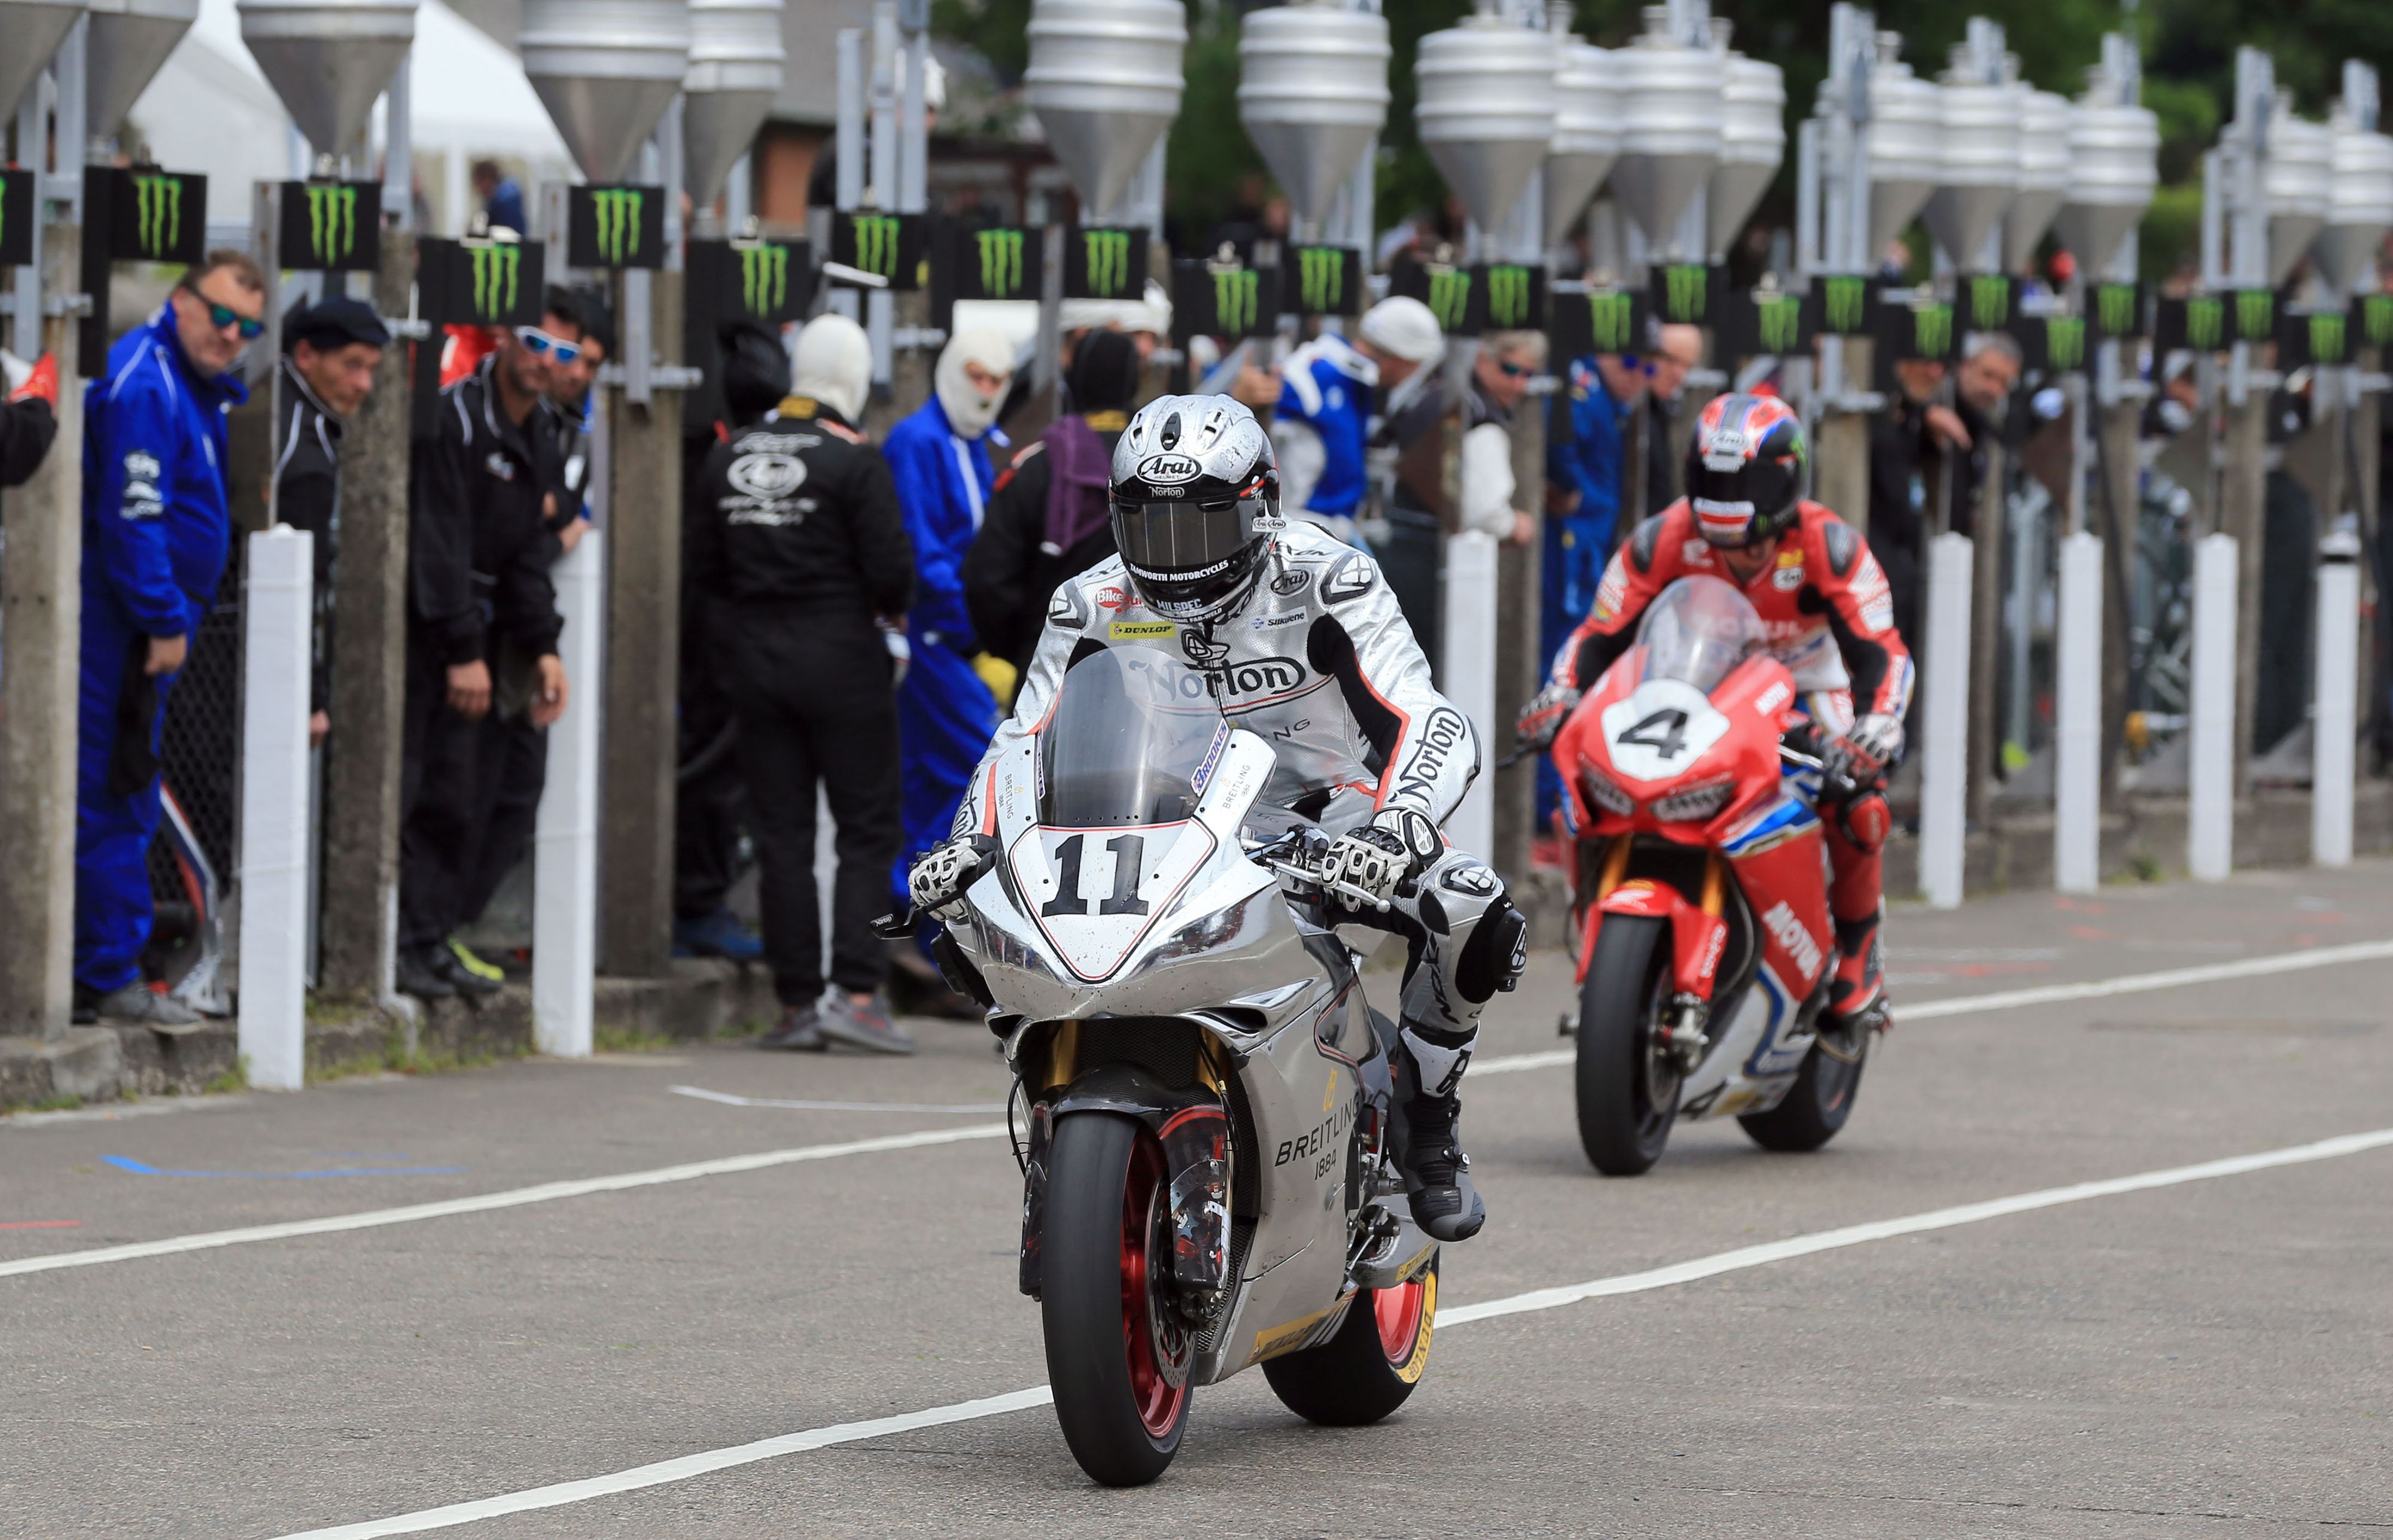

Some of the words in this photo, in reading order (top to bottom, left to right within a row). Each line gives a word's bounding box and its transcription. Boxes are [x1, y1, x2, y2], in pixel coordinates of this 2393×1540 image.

[1141, 456, 1194, 476] Arai
[1149, 486, 1185, 498] Norton
[1269, 518, 1285, 528] Arai
[1129, 563, 1168, 582] TAMWORTH
[1169, 560, 1229, 582] MOTORCYCLES
[1097, 589, 1125, 604] Bike
[1156, 598, 1202, 611] MILSPEC
[1124, 625, 1172, 634] DUNLOP
[1129, 656, 1307, 701] Norton
[1616, 708, 1688, 759] 4
[1193, 722, 1227, 793] BROOKES
[1388, 707, 1466, 811] Norton
[1004, 773, 1015, 820] BREITLING
[1223, 765, 1251, 809] BREITLING
[1241, 784, 1252, 798] 1884
[1042, 834, 1149, 918] 11
[1762, 900, 1823, 981] MOTUL
[1274, 1091, 1360, 1167] BREITLING
[1314, 1148, 1337, 1180] 1884
